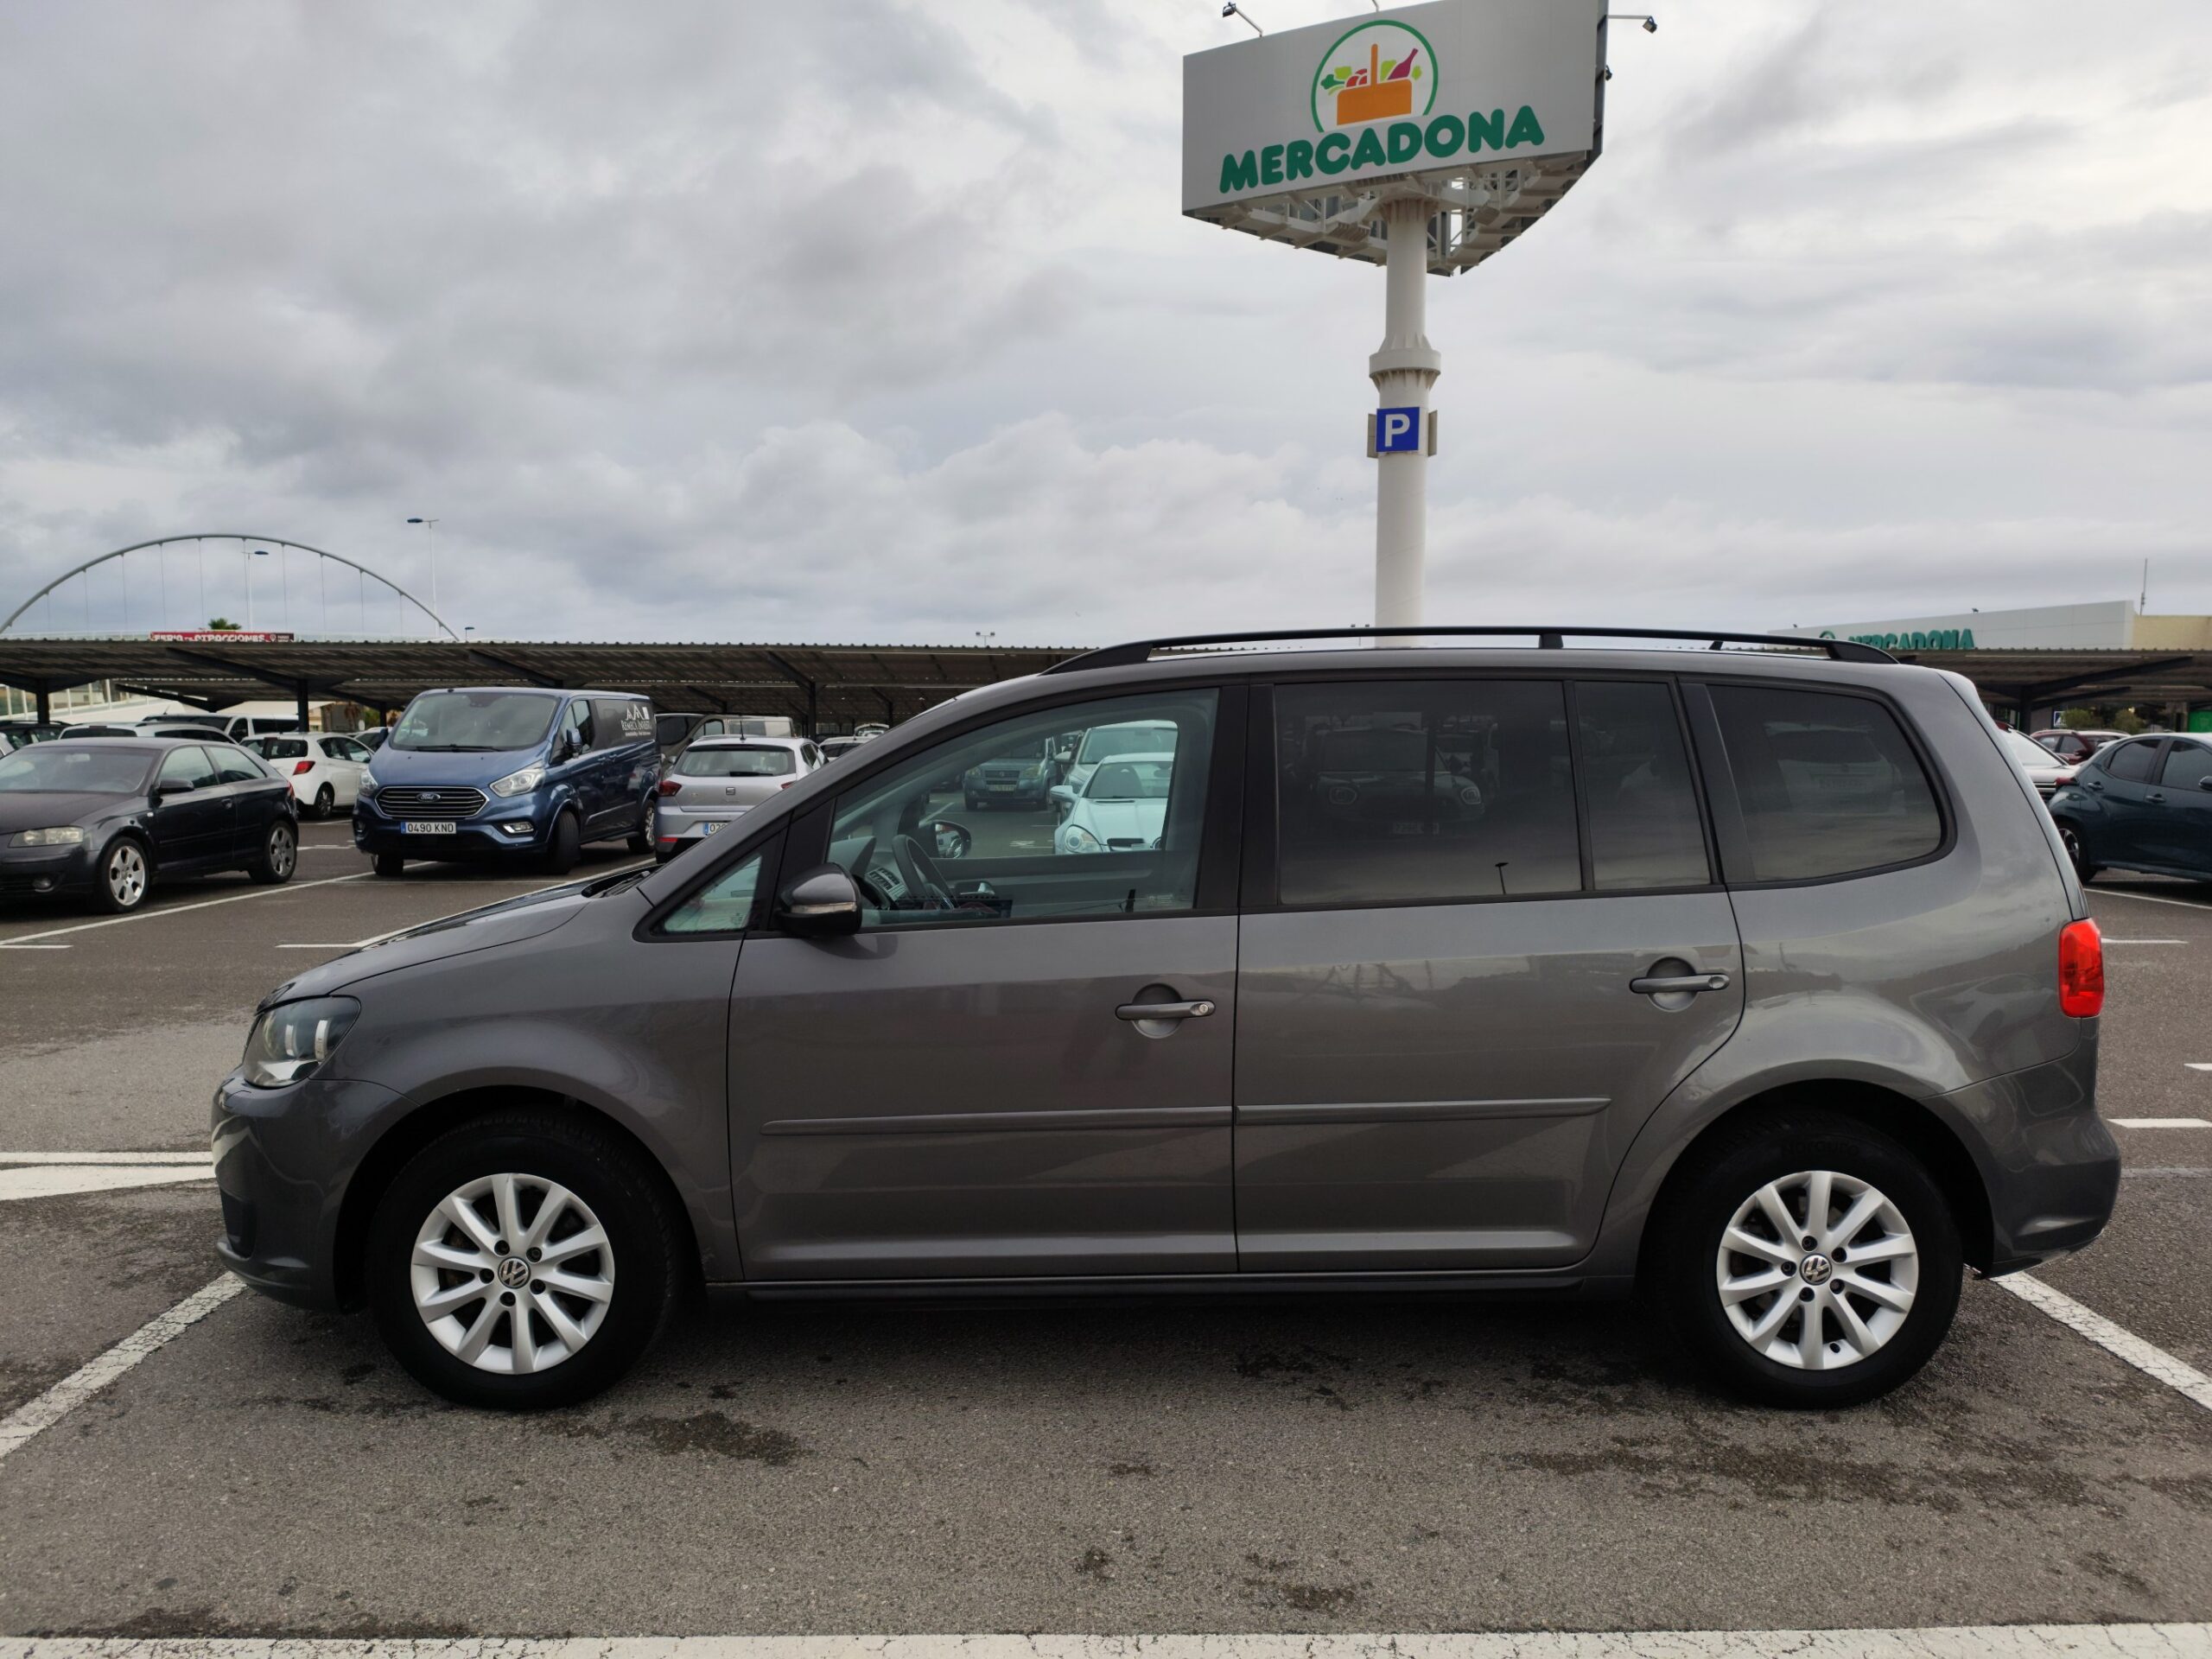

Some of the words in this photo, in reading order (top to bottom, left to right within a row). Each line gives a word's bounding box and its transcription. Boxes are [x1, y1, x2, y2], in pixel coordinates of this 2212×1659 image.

[1219, 105, 1545, 194] MERCADONA
[1385, 413, 1410, 448] P
[408, 823, 431, 832] 0490
[435, 823, 454, 832] KND
